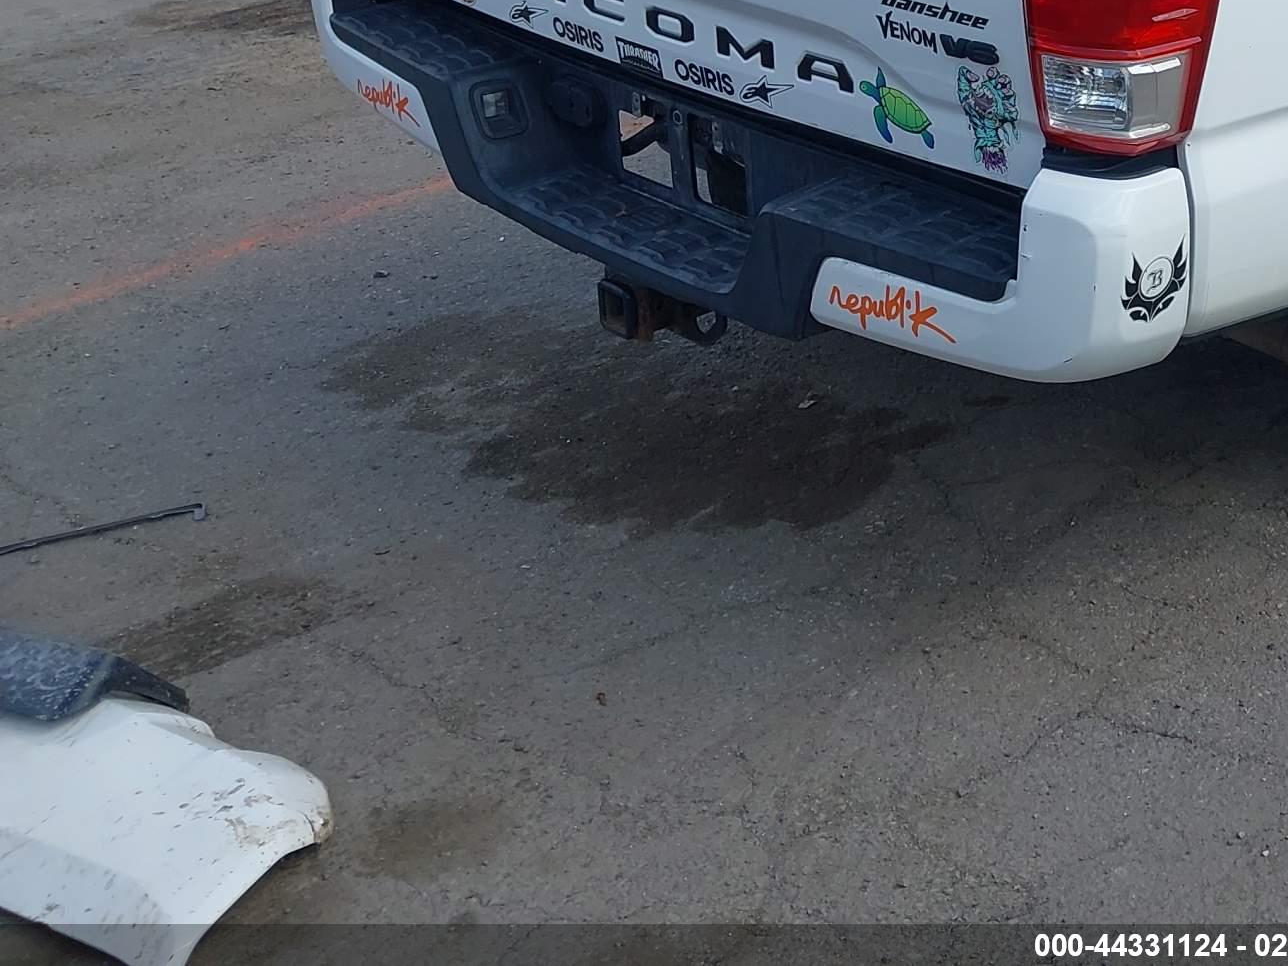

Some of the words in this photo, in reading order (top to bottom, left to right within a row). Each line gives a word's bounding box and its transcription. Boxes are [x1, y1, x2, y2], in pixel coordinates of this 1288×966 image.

[553, 16, 605, 53] OSIRIS
[876, 10, 938, 54] VENOM
[618, 40, 661, 72] THRASHER
[674, 58, 735, 96] OSIRIS
